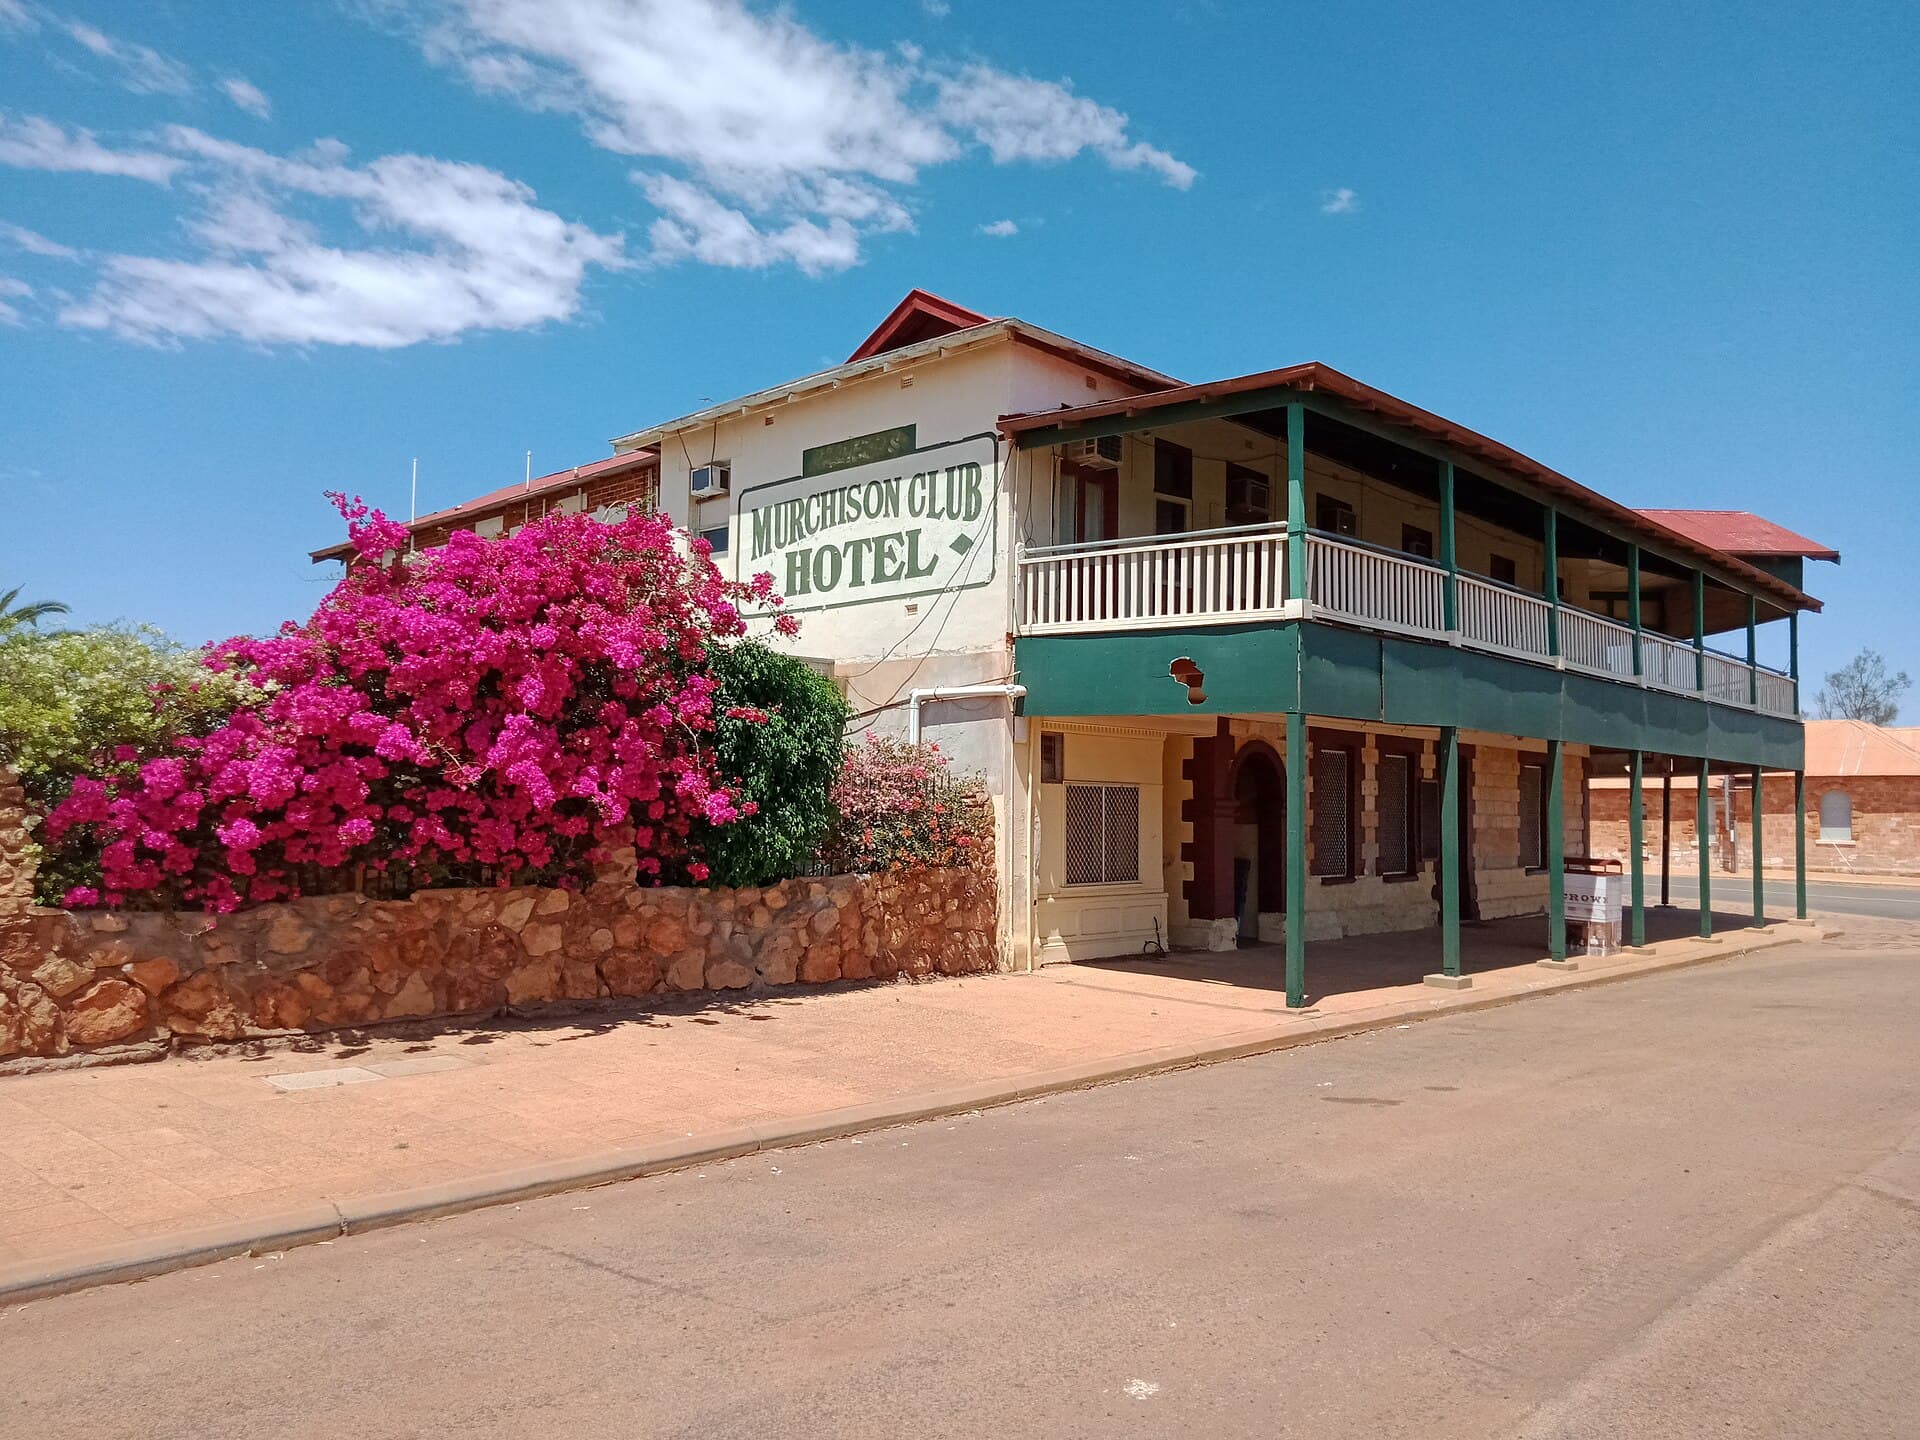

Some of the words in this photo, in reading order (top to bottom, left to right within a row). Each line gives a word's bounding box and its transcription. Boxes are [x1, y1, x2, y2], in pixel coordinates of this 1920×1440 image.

[751, 477, 902, 561] MURCHISON
[907, 461, 982, 522] CLUB
[784, 529, 939, 597] HOTEL
